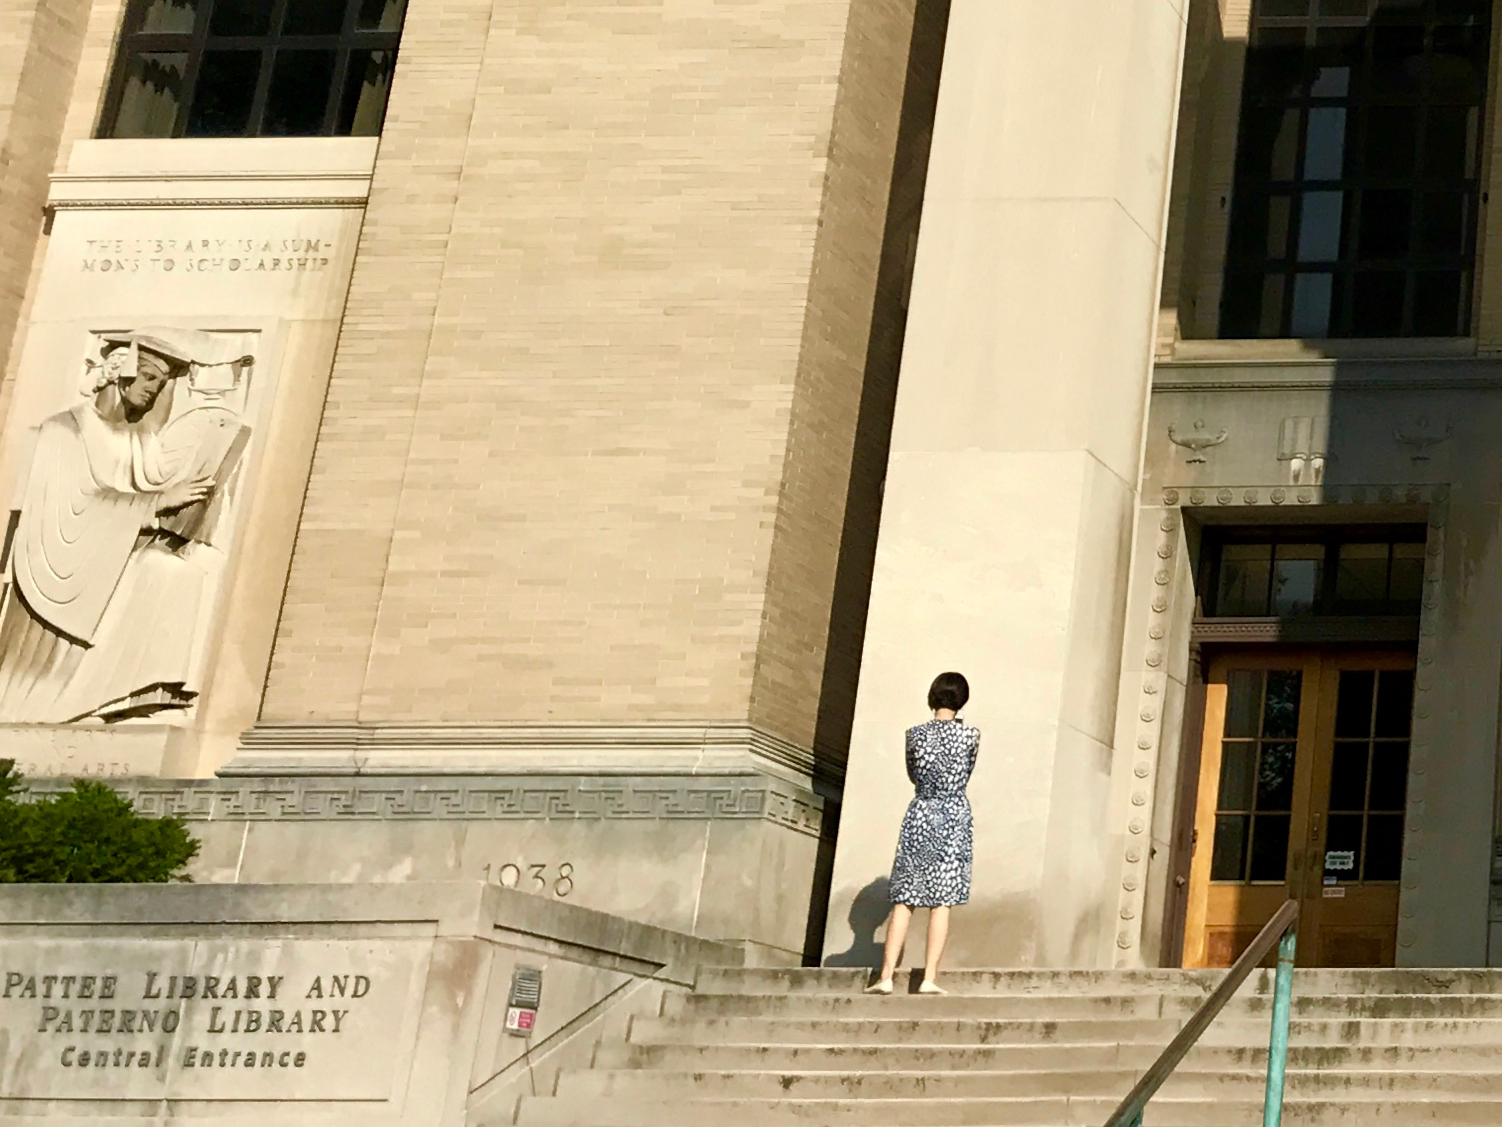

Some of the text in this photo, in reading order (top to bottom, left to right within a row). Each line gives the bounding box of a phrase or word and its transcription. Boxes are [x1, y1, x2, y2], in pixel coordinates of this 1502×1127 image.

[2, 970, 372, 1000] PATTEE LIBRARY AND
[37, 1005, 349, 1034] PATERNO LIBRARY
[60, 1045, 308, 1069] Central Entrance
